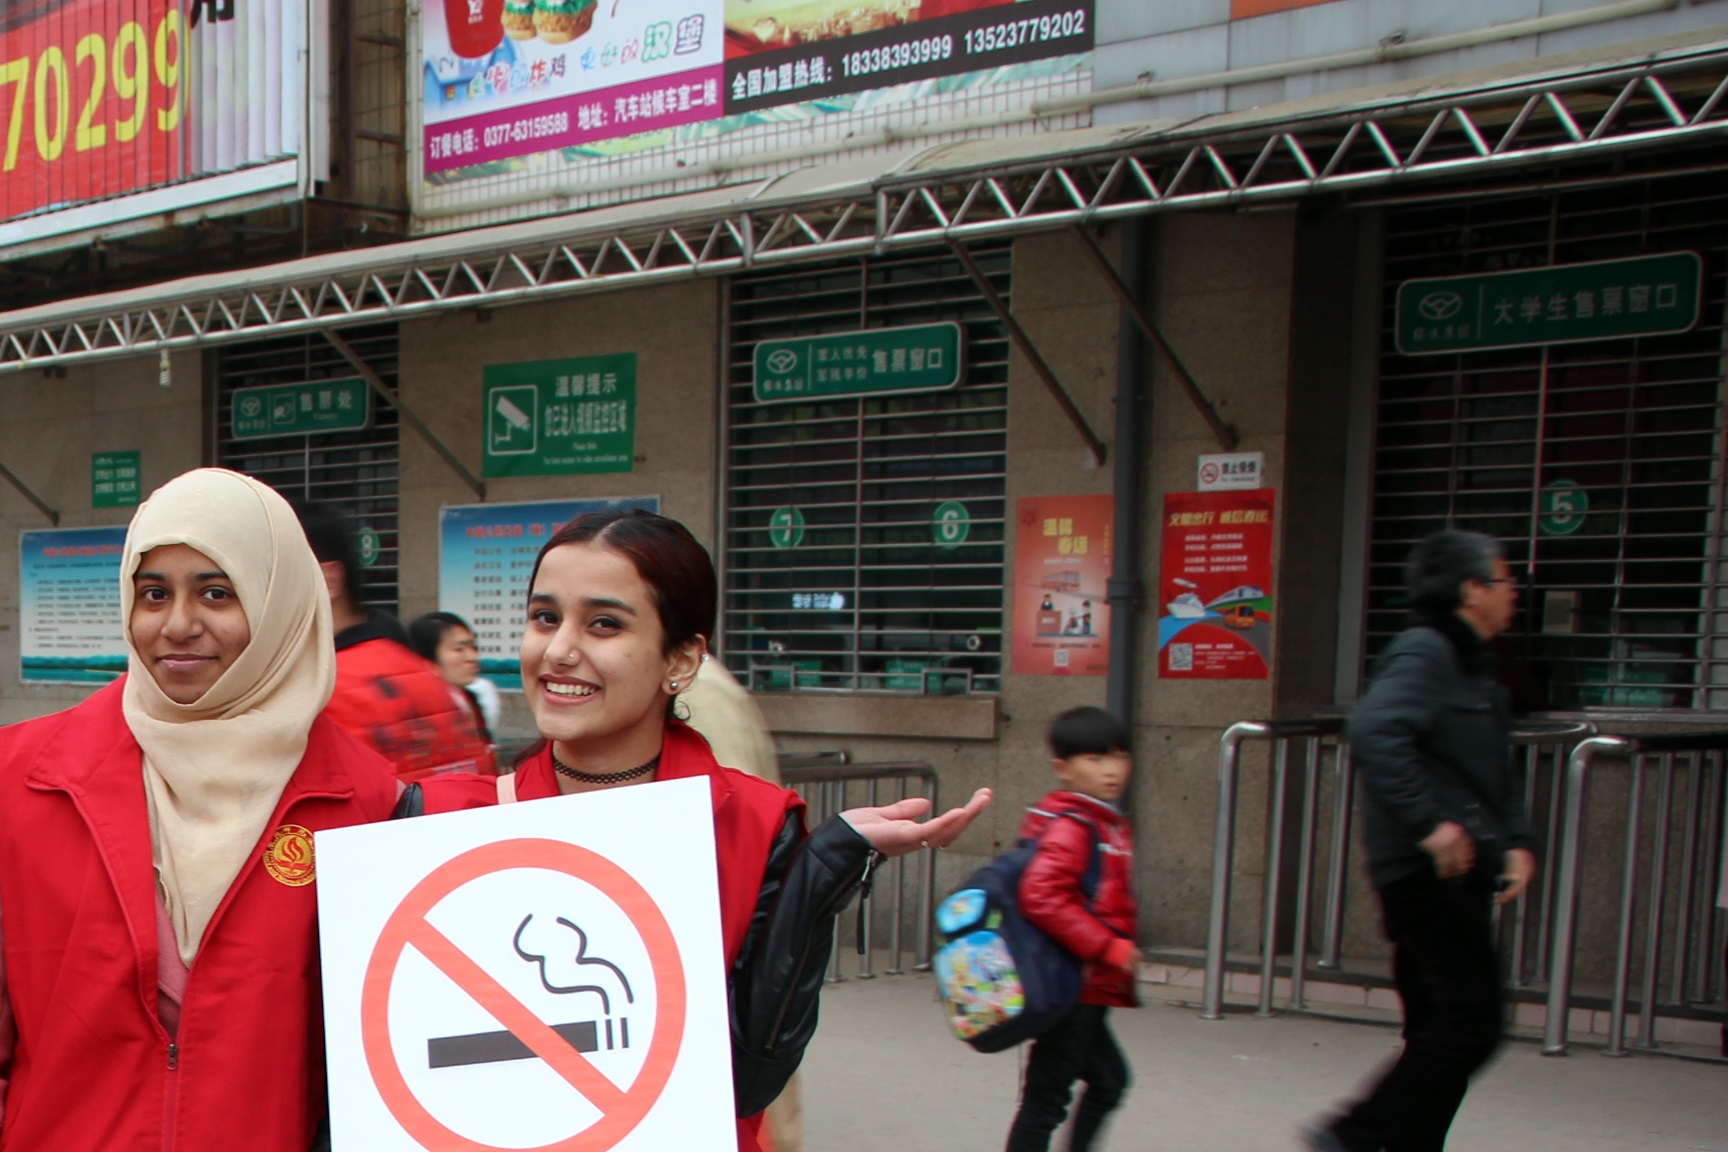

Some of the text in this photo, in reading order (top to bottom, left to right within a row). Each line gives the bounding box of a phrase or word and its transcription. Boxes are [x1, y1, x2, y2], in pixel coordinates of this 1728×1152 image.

[963, 9, 1086, 55] 13523779202
[1492, 283, 1678, 325] 大学生售票窗口
[872, 347, 944, 374] 售票窗口
[1551, 490, 1575, 524] 5
[780, 513, 793, 541] 7
[941, 510, 960, 539] 6
[361, 533, 373, 558] 8
